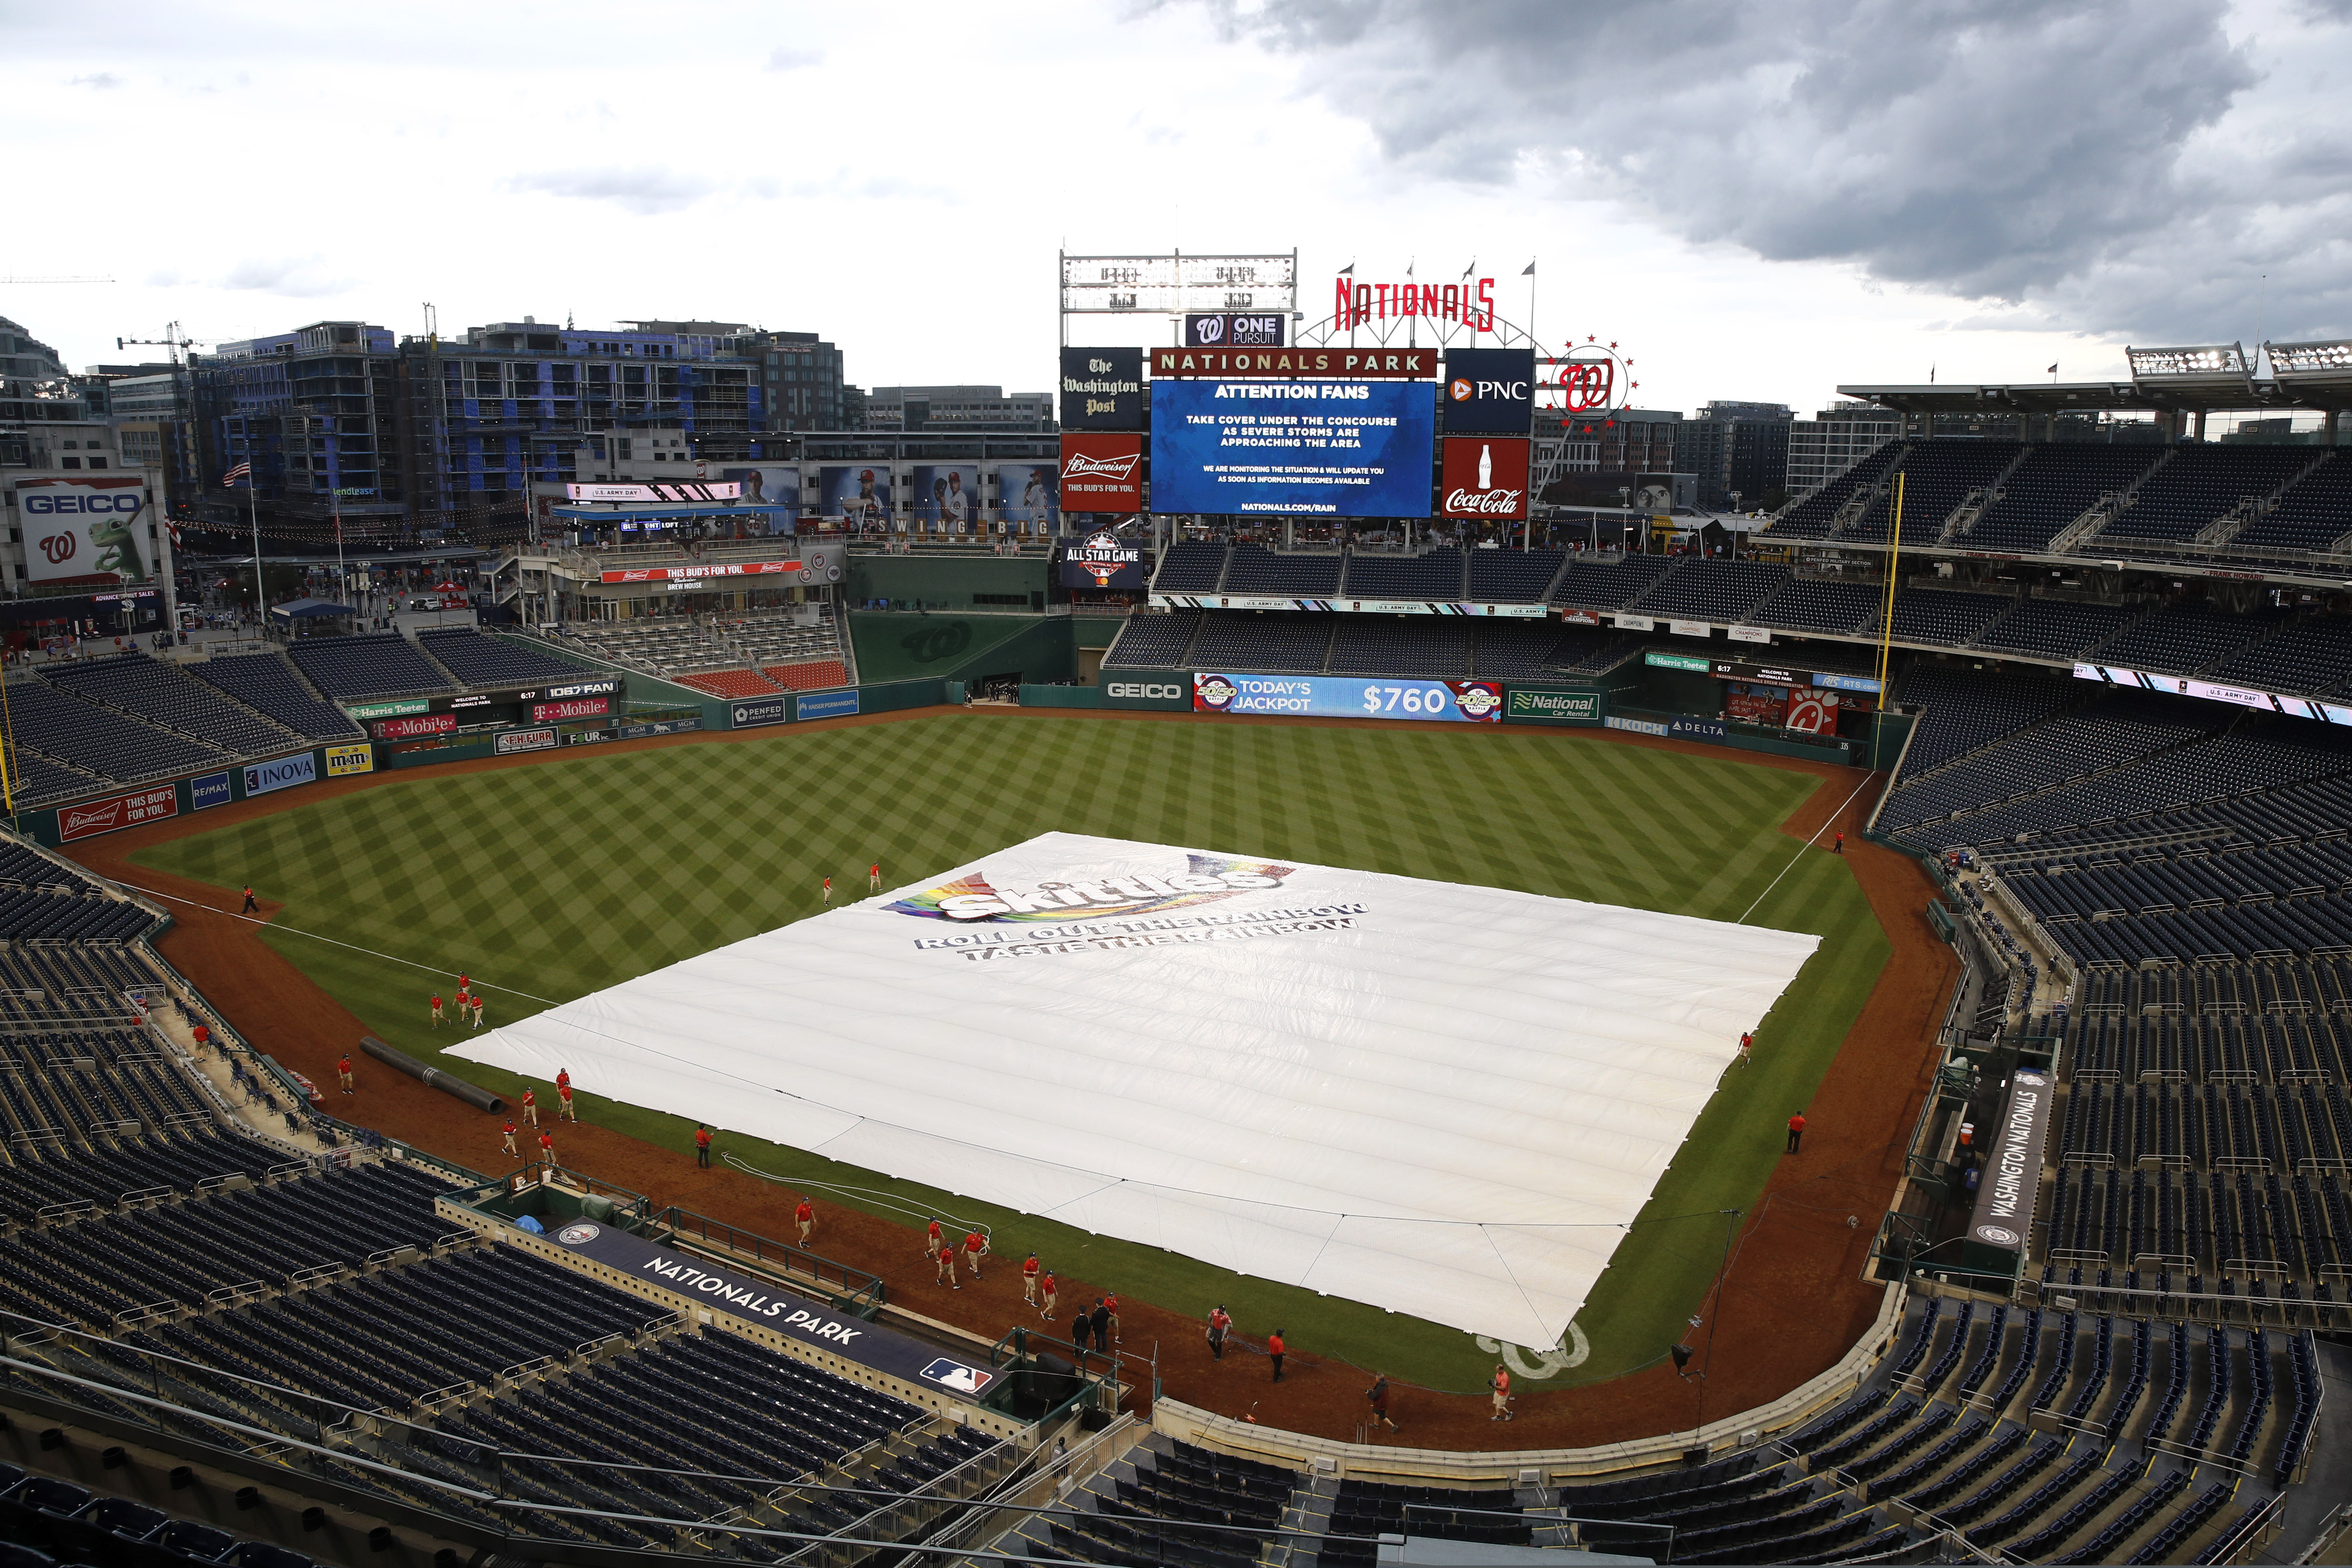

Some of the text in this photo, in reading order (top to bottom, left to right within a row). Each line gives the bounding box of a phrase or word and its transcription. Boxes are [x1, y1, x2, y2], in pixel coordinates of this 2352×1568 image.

[1336, 278, 1494, 332] NATIONALS
[1234, 318, 1276, 333] ONE
[1234, 333, 1276, 343] PURSUIT
[1089, 358, 1113, 375] The
[1161, 354, 1420, 371] NATIONALS PARK
[1063, 375, 1139, 396] Washington
[1215, 385, 1369, 400] ATTENTION FANS
[1476, 381, 1527, 400] PNC
[1086, 399, 1116, 417] Post
[1186, 415, 1397, 426] TAKE COVER UNDER THE CONCOURSE
[1241, 428, 1284, 436] SEVERE
[1287, 428, 1333, 437] STORMS
[1337, 428, 1359, 437] ARE
[1220, 438, 1361, 448] APPROACHING THE AREA
[1068, 459, 1132, 472] Budweiser
[26, 494, 140, 514] GEICO
[1242, 503, 1336, 512] NATIONALS.COM/RAIN
[1446, 488, 1522, 513] Coca-Cola
[1067, 549, 1138, 562] ALL STAR GAME
[667, 565, 744, 578] THIS BUD'S FOR YOU.
[2234, 572, 2264, 581] HOWARD
[1656, 658, 1707, 670] Harris Teeter
[1239, 681, 1311, 695] TODAY'S
[1822, 675, 1840, 687] RTS
[1843, 679, 1877, 691] RTS.com
[550, 682, 614, 697] 106.7 FAN
[1108, 683, 1181, 699] GEICO
[1196, 686, 1238, 697] 50/50
[825, 699, 856, 708] PERMANENTE
[1234, 697, 1311, 710] JACKPOT
[1363, 686, 1446, 713] $760
[1456, 695, 1501, 706] 50/50
[361, 704, 426, 717] Harris Teeter
[749, 706, 781, 716] PENFED
[1685, 723, 1724, 736] DELTA
[263, 760, 314, 785] INOVA
[194, 782, 228, 798] RE/MAX
[126, 790, 173, 809] THIS BUD'S
[68, 812, 116, 828] Budweiser
[128, 804, 166, 821] FOR YOU.
[914, 902, 1371, 949] ROLL OUT THE RAINBOW
[957, 918, 1360, 960] TASTE THE RAINBOW
[1990, 1090, 2038, 1218] WASHINGTON NATIONALS
[643, 1256, 863, 1346] NATIONALS PARK
